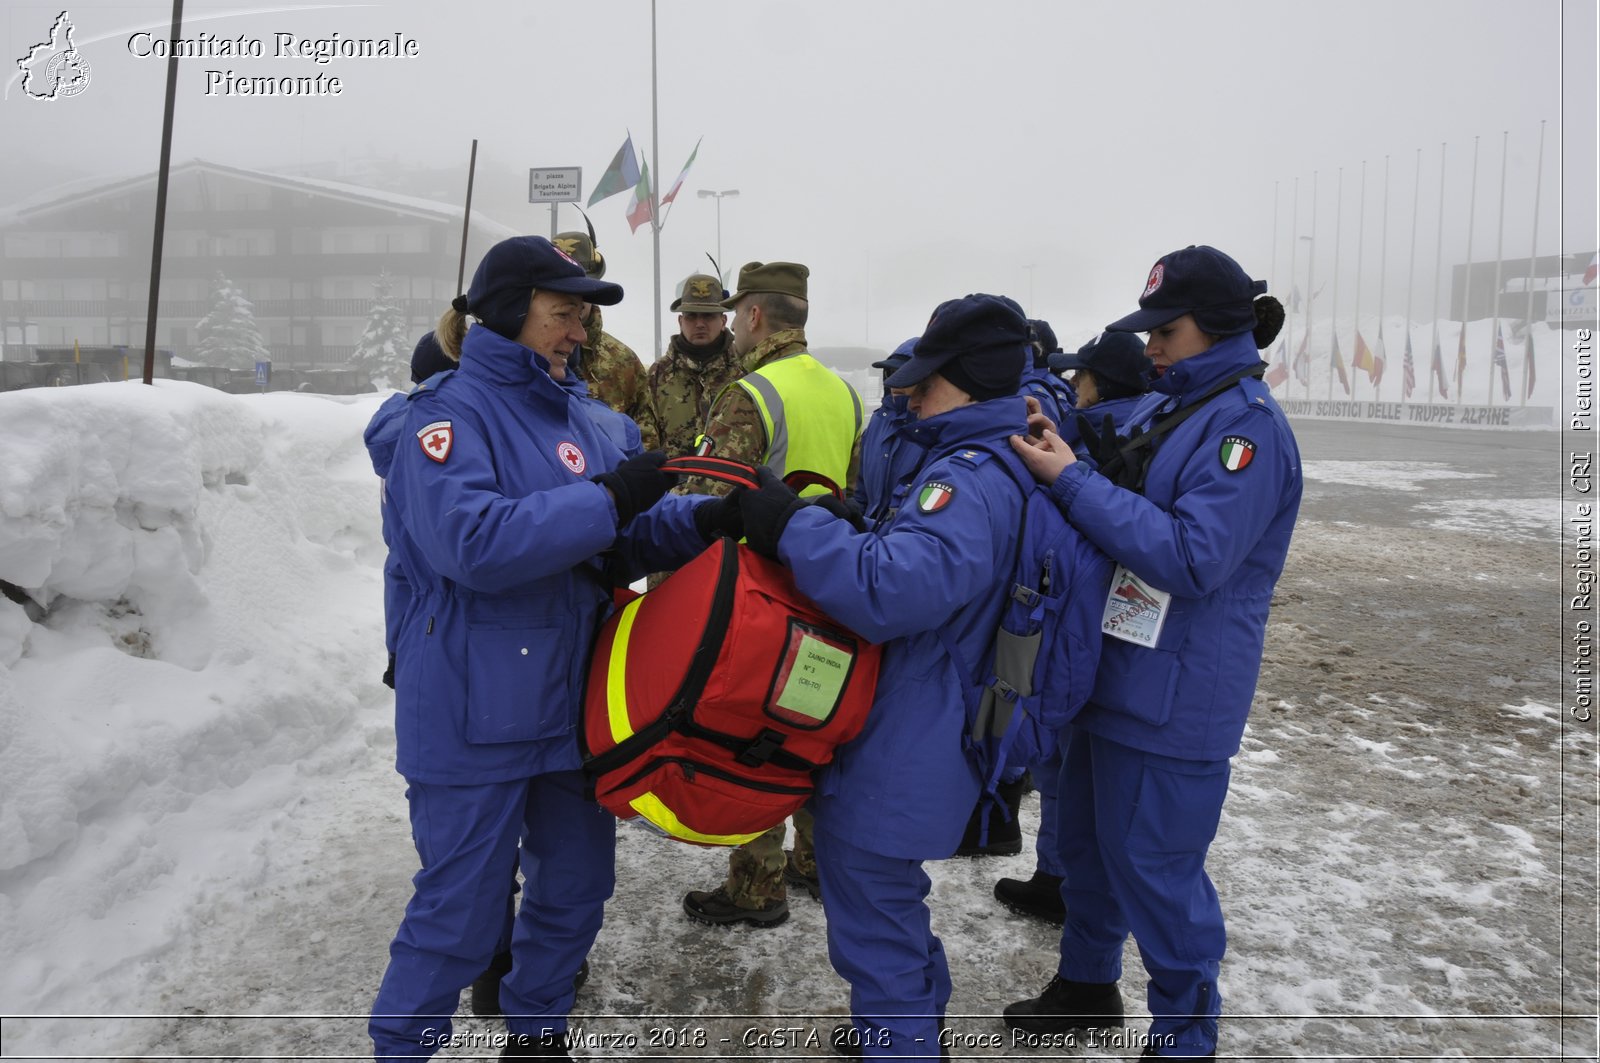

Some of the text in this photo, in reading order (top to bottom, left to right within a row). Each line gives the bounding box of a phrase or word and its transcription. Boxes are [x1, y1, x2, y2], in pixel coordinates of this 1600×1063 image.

[1367, 403, 1402, 420] DELLE
[1408, 405, 1455, 423] TRUPPE
[1460, 407, 1511, 425] ALPINE
[1226, 437, 1253, 450] ITALIA
[928, 482, 953, 493] ITALIA
[807, 651, 842, 669] ZAINO INDIA
